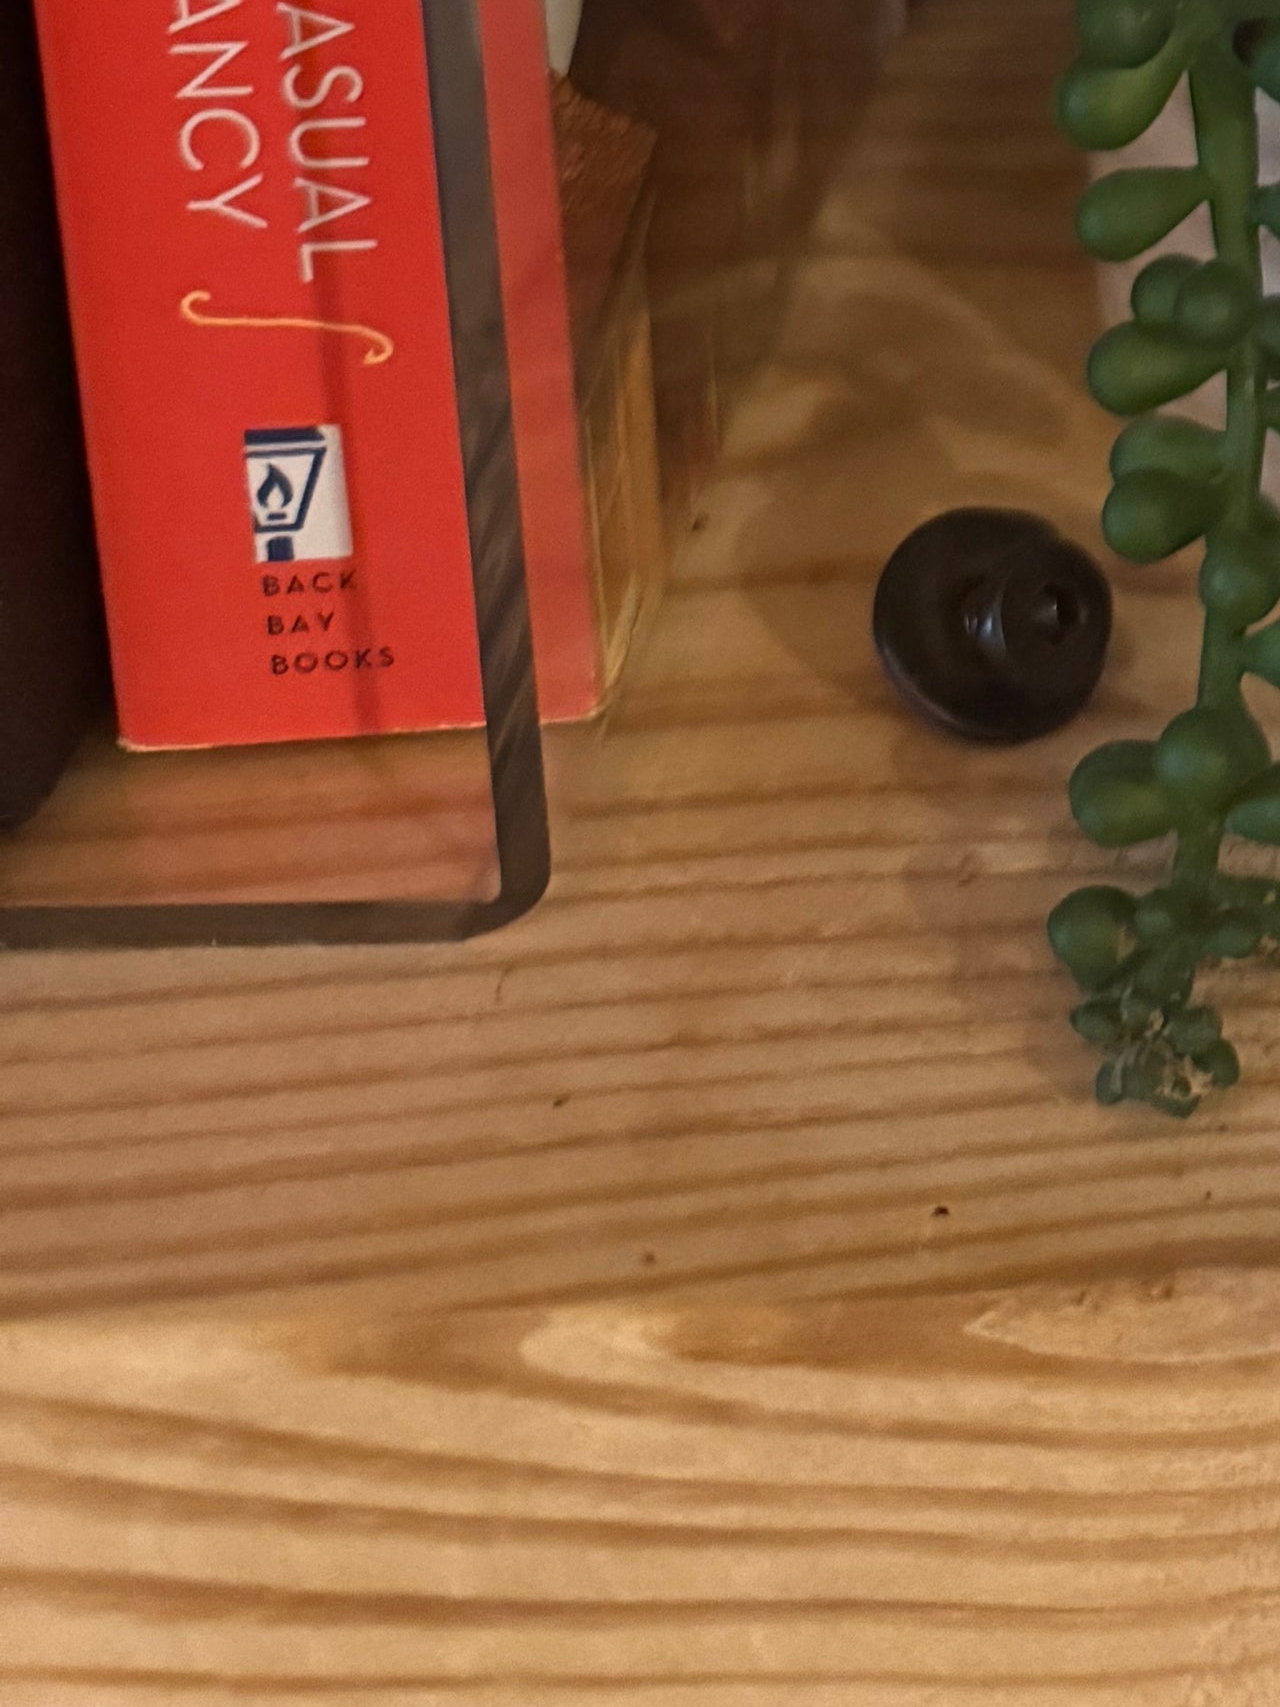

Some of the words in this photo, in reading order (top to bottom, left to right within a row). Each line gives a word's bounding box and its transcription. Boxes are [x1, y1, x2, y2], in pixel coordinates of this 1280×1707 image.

[261, 569, 357, 597] BACK
[267, 611, 335, 636] BAY
[271, 646, 395, 675] BOOKS
